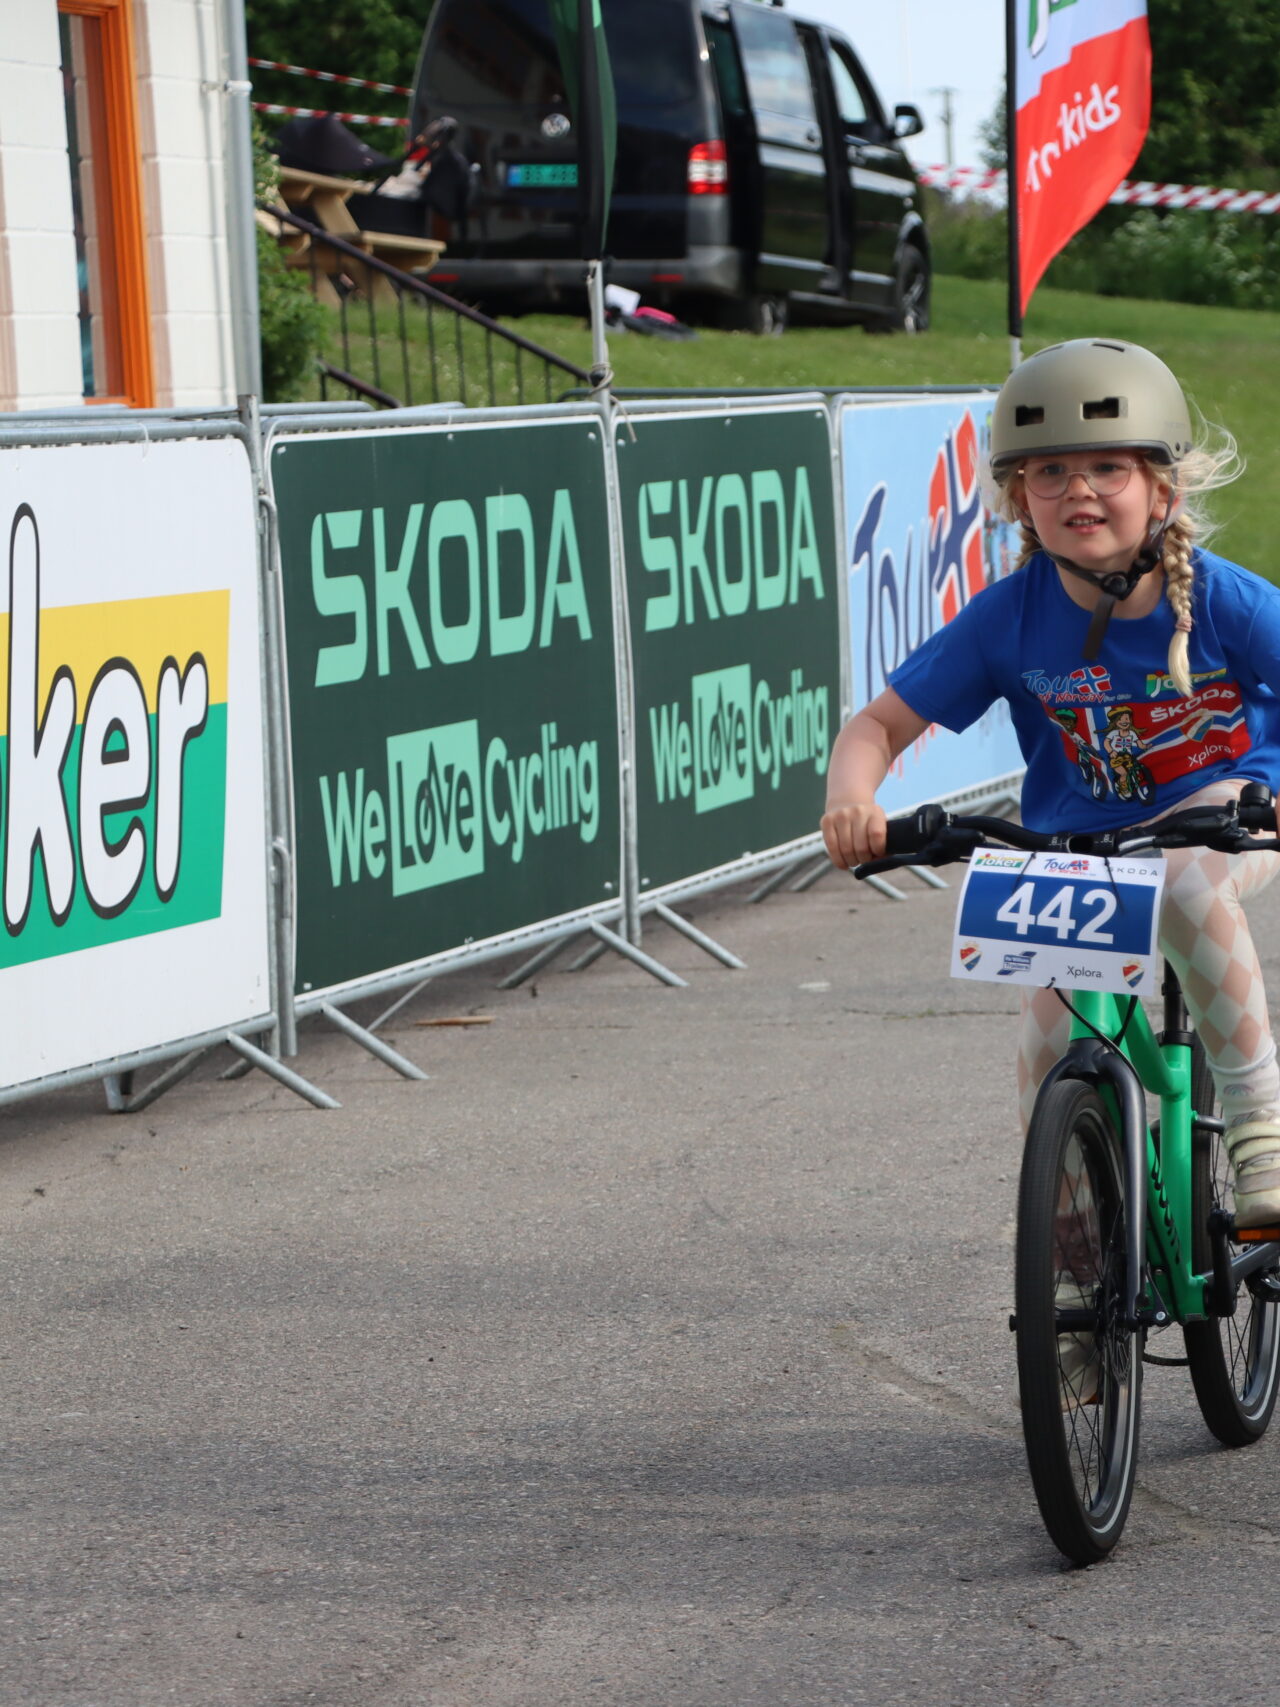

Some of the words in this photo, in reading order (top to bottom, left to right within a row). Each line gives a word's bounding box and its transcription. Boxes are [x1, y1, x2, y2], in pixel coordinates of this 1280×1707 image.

[1057, 82, 1121, 151] kids
[1021, 669, 1083, 695] Tour
[650, 701, 692, 804] We
[753, 668, 828, 790] Cycling
[319, 768, 386, 887] We
[485, 722, 599, 863] Cycling
[996, 881, 1117, 944] 442
